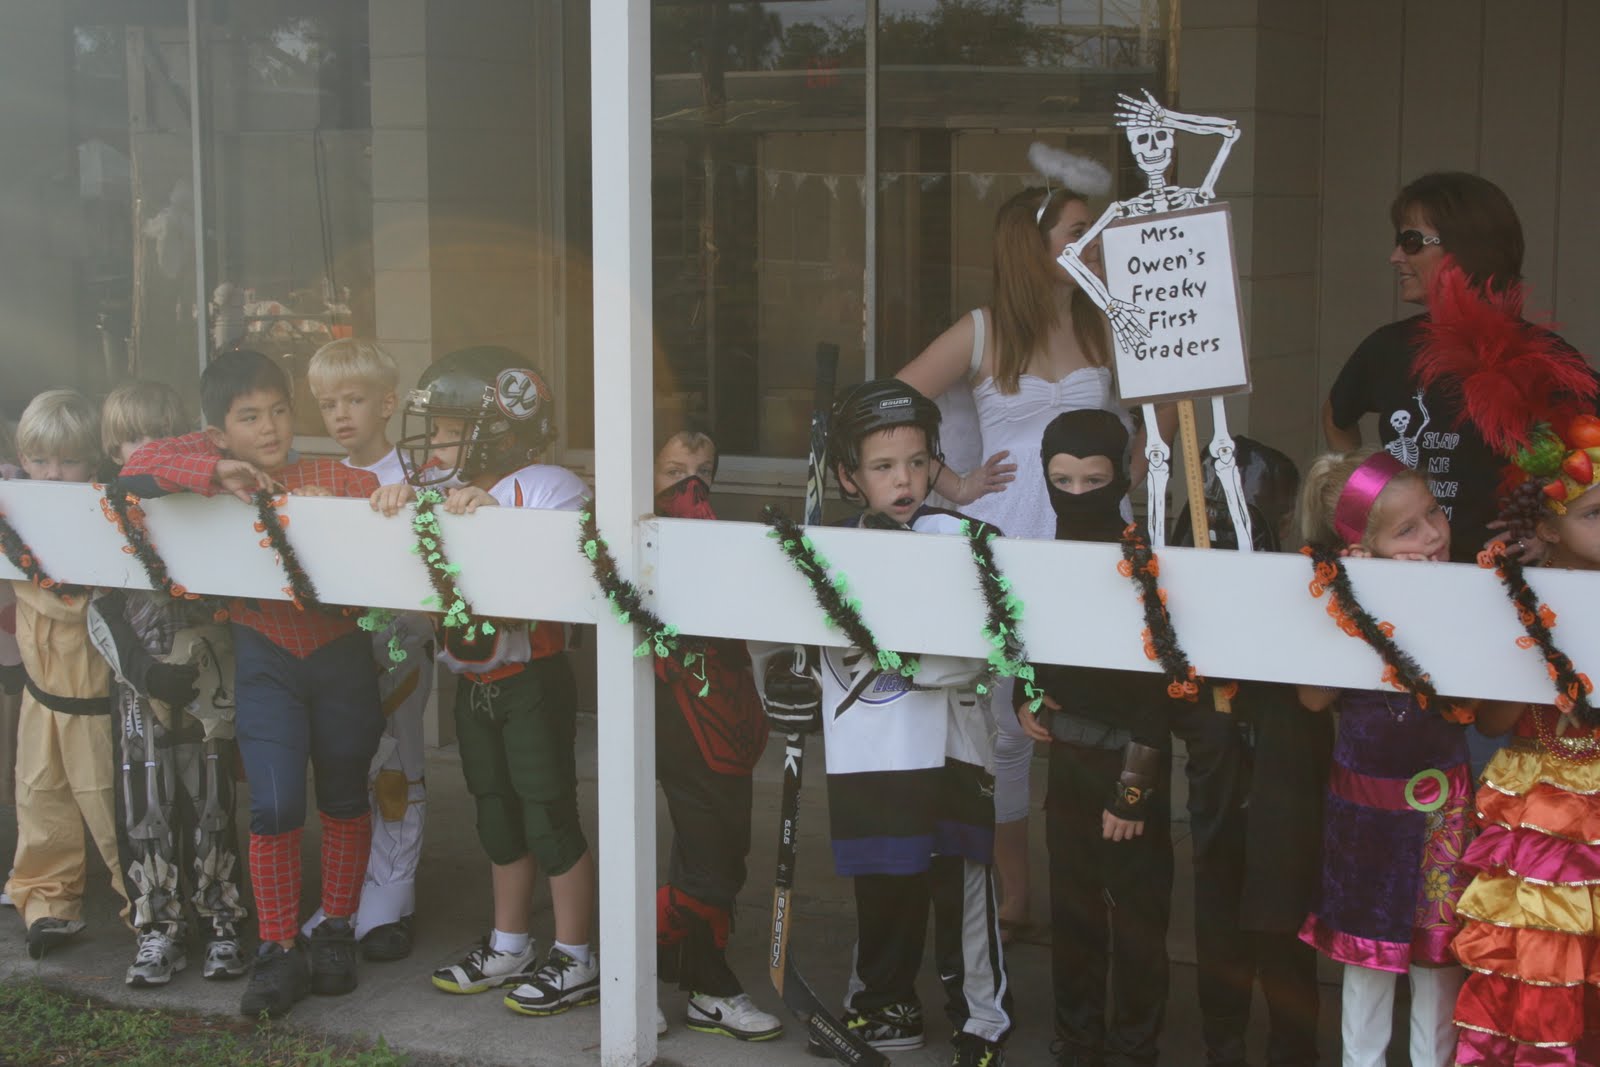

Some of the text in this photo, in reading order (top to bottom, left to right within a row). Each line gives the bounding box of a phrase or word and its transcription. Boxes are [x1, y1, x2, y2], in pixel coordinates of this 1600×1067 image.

[1141, 226, 1185, 244] Mrs.
[1128, 248, 1206, 274] Owen's
[1132, 278, 1206, 303] Freaky
[1149, 309, 1198, 330] First
[1135, 337, 1220, 361] Graders
[881, 398, 910, 407] BAUER
[1422, 431, 1460, 450] SLAP
[1428, 457, 1450, 473] ME
[772, 896, 786, 968] EASTON
[811, 1016, 862, 1060] COMPOSITE
